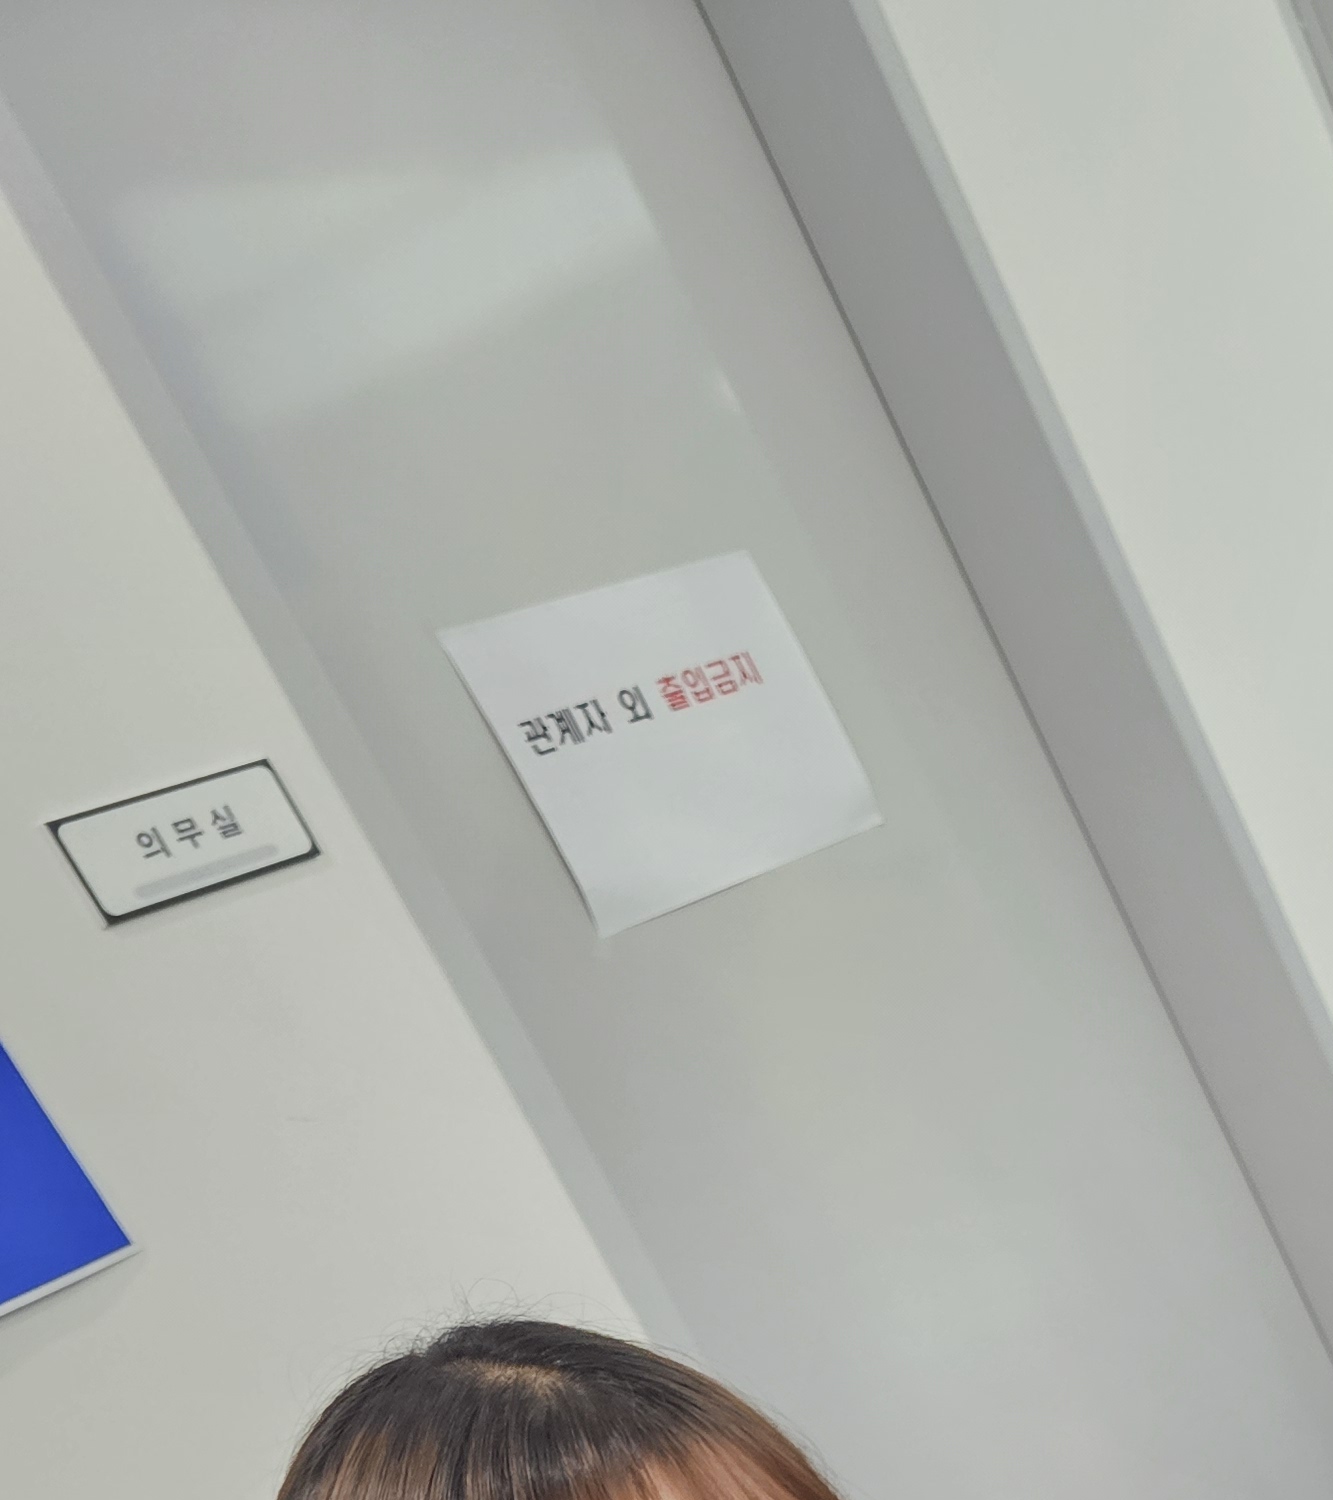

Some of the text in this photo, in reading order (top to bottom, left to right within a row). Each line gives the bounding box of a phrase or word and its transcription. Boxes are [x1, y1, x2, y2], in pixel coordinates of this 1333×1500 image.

[517, 651, 764, 756] 관계자 외 출입금지
[136, 805, 243, 858] 의무실
